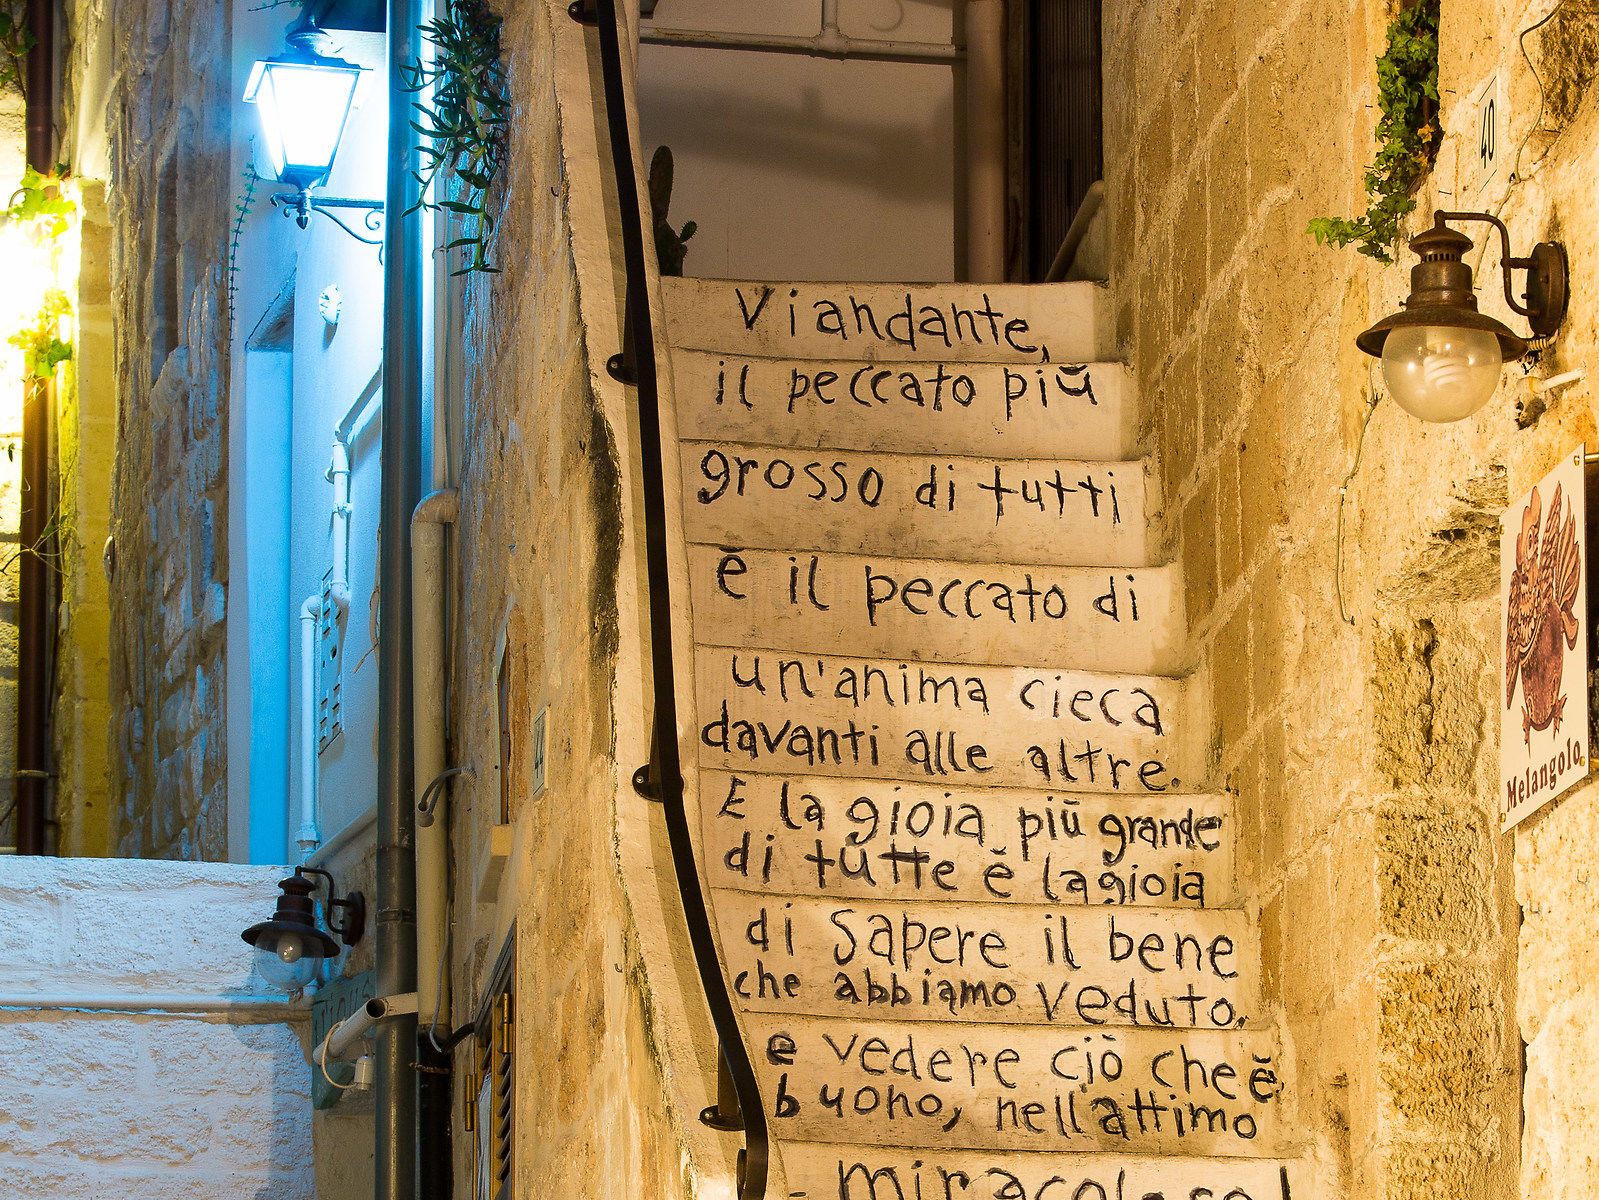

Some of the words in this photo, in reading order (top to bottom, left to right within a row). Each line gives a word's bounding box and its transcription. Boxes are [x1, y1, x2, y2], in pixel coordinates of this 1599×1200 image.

[1481, 98, 1494, 170] 40
[734, 287, 1051, 363] Viandante,
[716, 361, 754, 410] il
[787, 364, 977, 414] peccato
[697, 450, 883, 506] grosso
[915, 464, 955, 511] di
[977, 466, 1122, 525] tutti
[788, 556, 830, 611] il
[866, 565, 1067, 626] peccato
[1093, 574, 1139, 623] di
[731, 653, 990, 714] un'anima
[1019, 676, 1166, 737] cieca
[701, 700, 880, 766] davanti
[905, 727, 996, 775] alle
[1026, 737, 1182, 792] altre.
[1507, 737, 1580, 812] Melangolo
[718, 776, 746, 820] E
[780, 781, 825, 831] la
[845, 786, 986, 848] gioia
[1099, 811, 1224, 865] grande
[724, 831, 774, 882] di
[804, 839, 959, 891] tutte
[746, 902, 793, 955] di
[1044, 914, 1080, 969] il
[1109, 914, 1238, 979] bene
[734, 968, 802, 1001] che
[834, 971, 1016, 1015] abbiamo
[766, 1030, 798, 1065] e
[822, 1032, 1021, 1089] vedere
[1050, 1035, 1122, 1086] ciò
[1152, 1048, 1236, 1101] che
